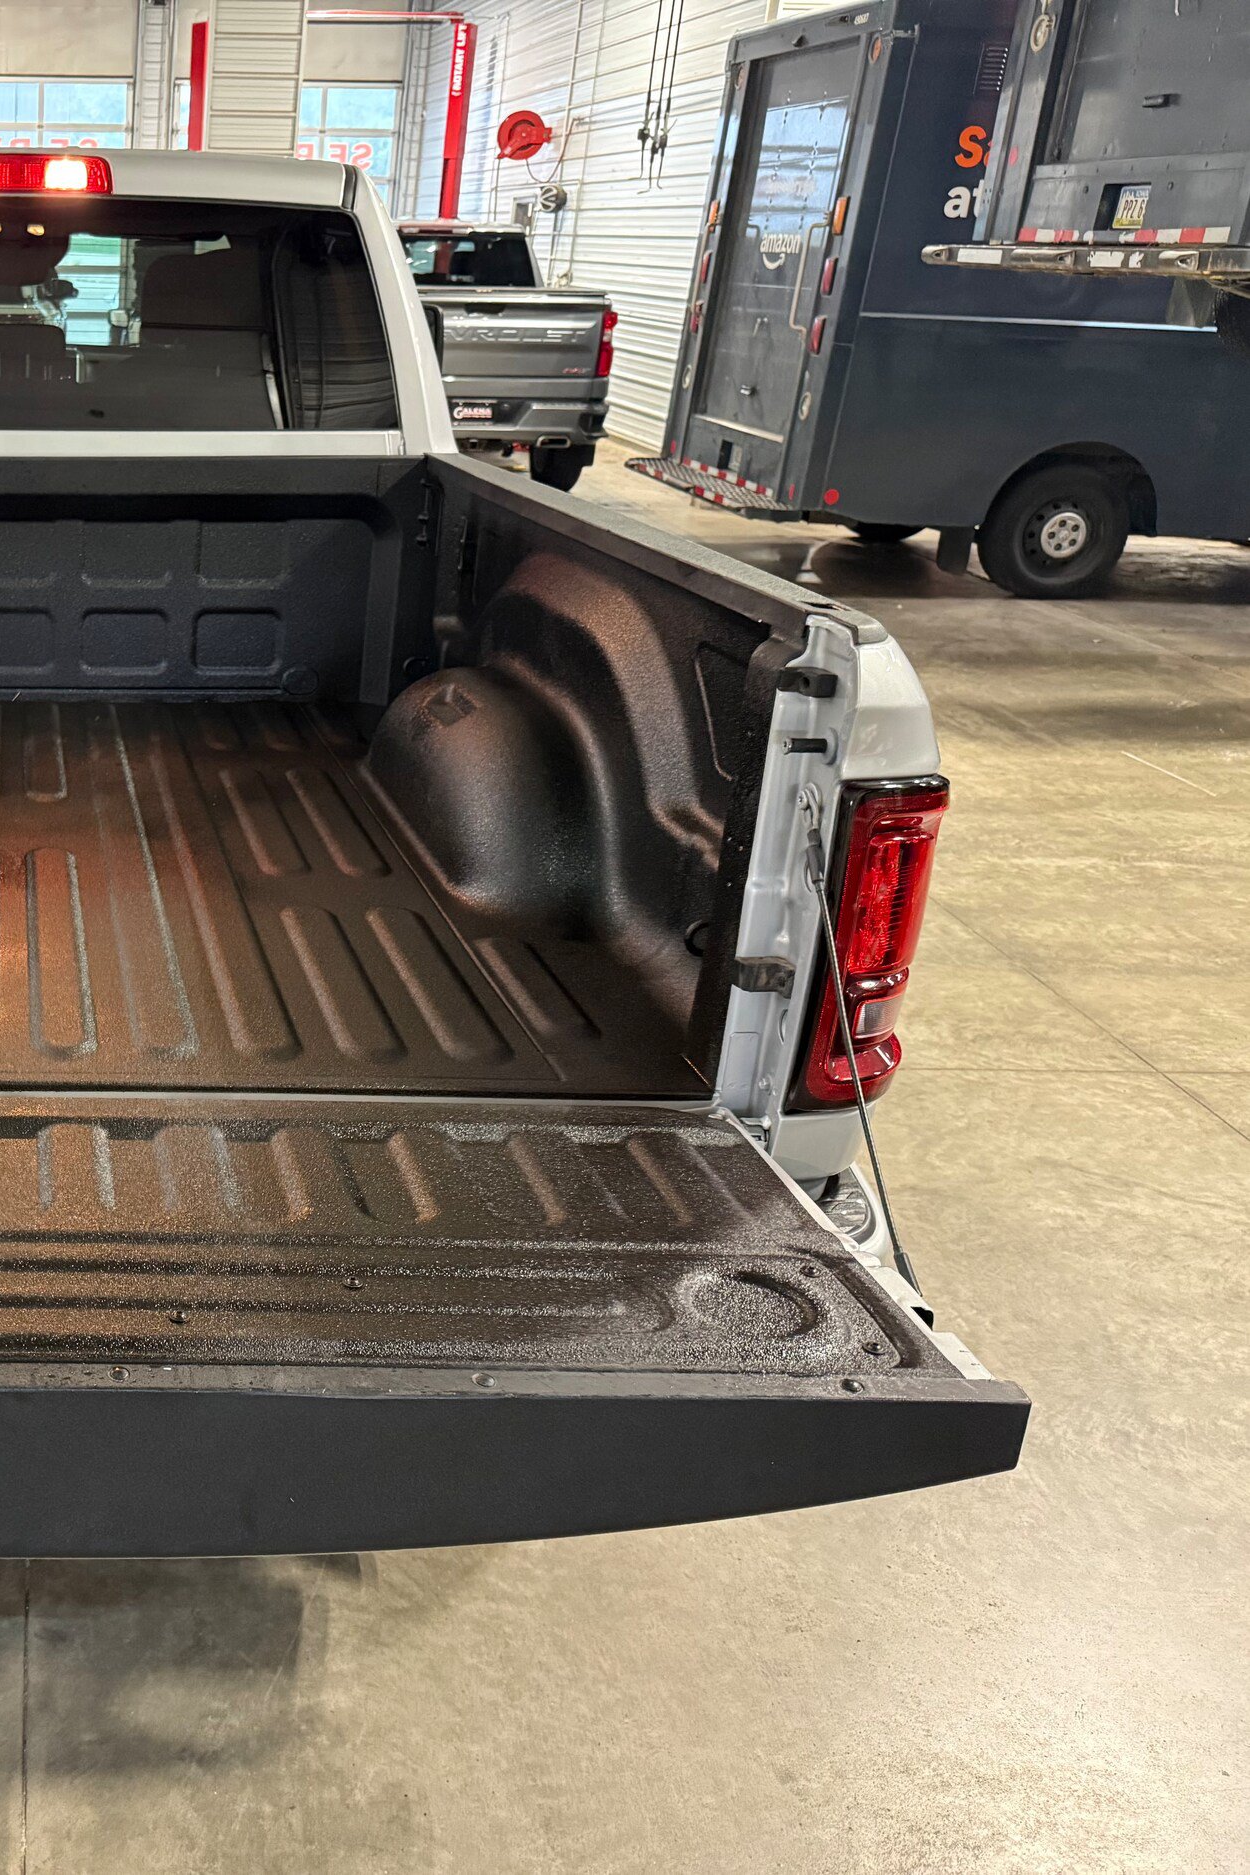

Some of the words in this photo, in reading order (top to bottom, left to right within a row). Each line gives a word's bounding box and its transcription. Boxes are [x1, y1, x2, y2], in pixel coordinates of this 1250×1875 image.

[456, 24, 468, 47] LIFT
[452, 48, 465, 91] ROTARY
[954, 125, 993, 169] S
[760, 233, 801, 254] amazon
